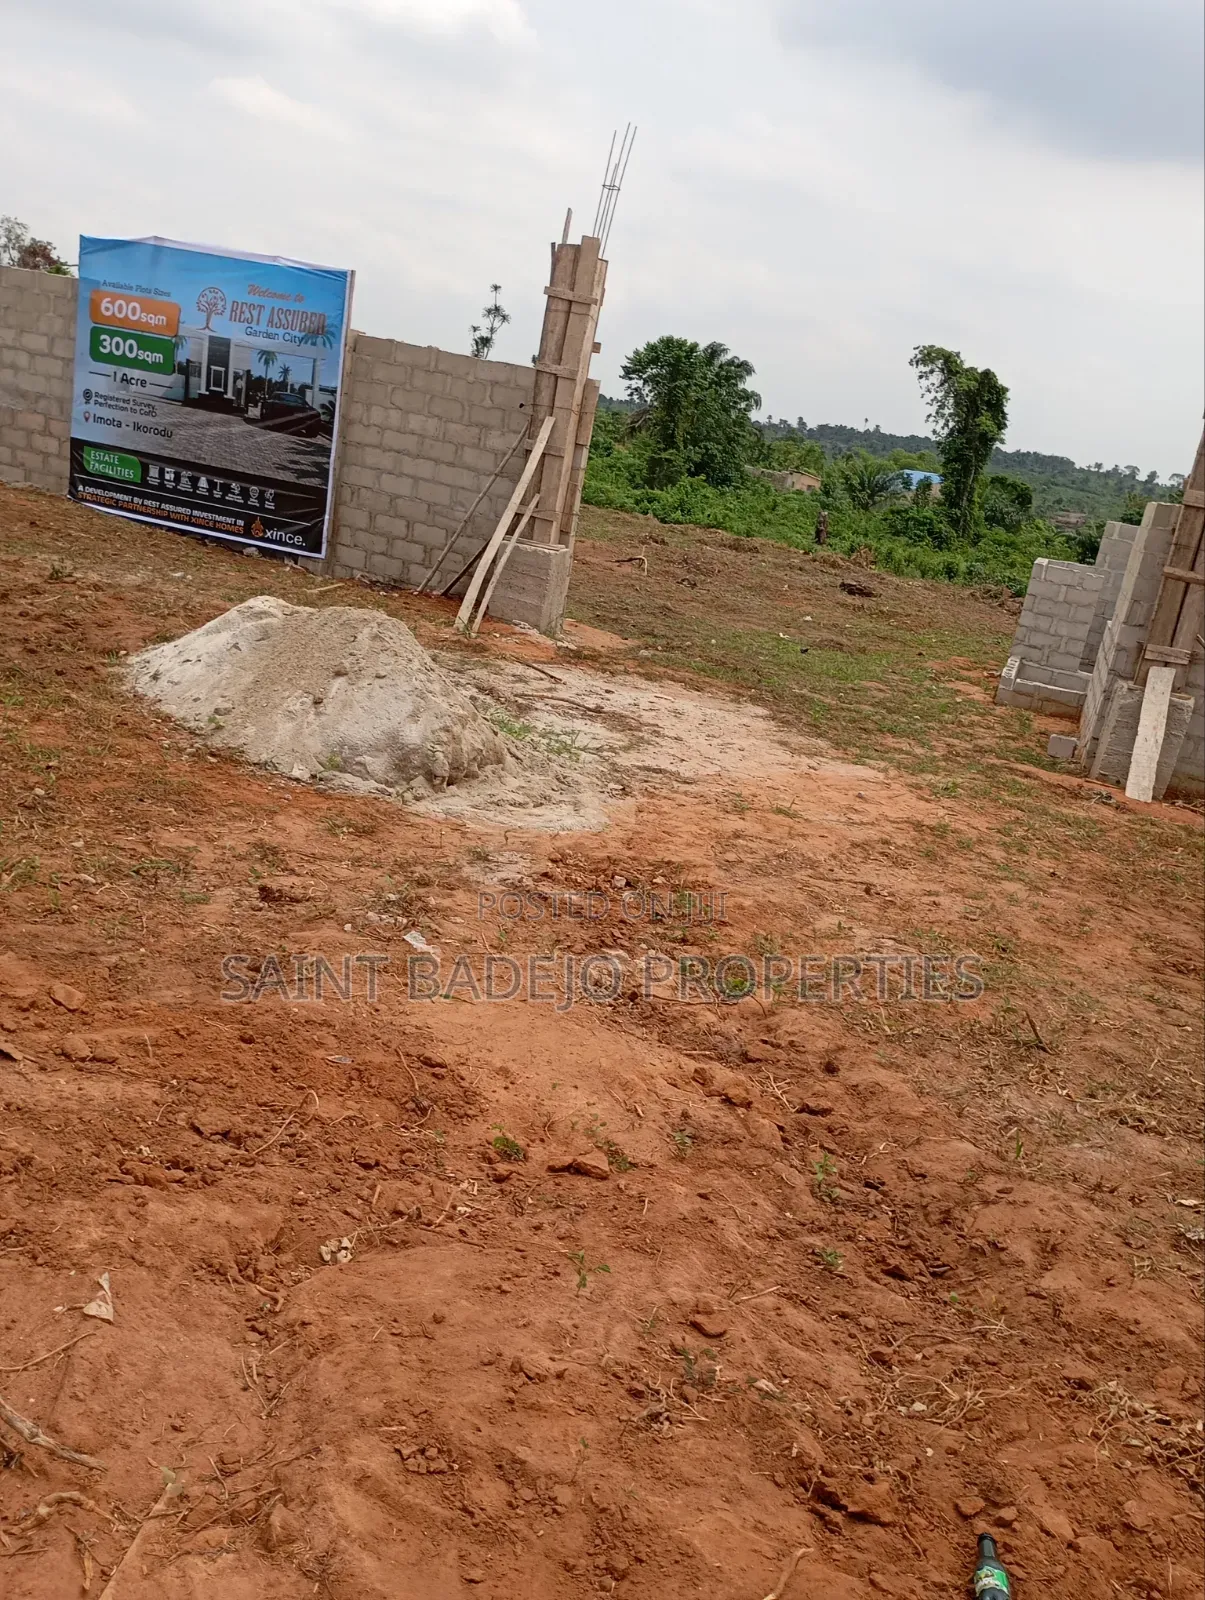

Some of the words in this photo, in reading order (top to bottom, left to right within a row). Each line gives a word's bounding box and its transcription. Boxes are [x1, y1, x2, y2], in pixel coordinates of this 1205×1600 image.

[248, 284, 291, 301] Welcome
[294, 292, 305, 303] to
[101, 298, 166, 326] 600sqm
[230, 300, 265, 326] REST
[245, 326, 280, 340] Garden
[282, 332, 304, 346] City
[99, 334, 164, 363] 300sqm
[120, 373, 147, 388] Acre
[94, 392, 130, 404] Registered
[94, 400, 128, 412] Perfection
[93, 414, 122, 428] Imota
[133, 422, 173, 438] Ikorodu
[90, 450, 120, 464] ESTATE
[90, 462, 134, 478] FACILITIES
[78, 492, 118, 506] STRATEGIC
[118, 500, 168, 516] PARTNERSHIP
[170, 512, 190, 522] WITH
[190, 516, 214, 528] XINCE
[216, 522, 244, 534] HOMES
[85, 486, 132, 502] DEVELOPMENT
[134, 496, 142, 504] BY
[144, 499, 160, 508] REST
[160, 503, 192, 515] ASSURED
[192, 510, 236, 525] INVESTMENT
[264, 528, 306, 546] xince.
